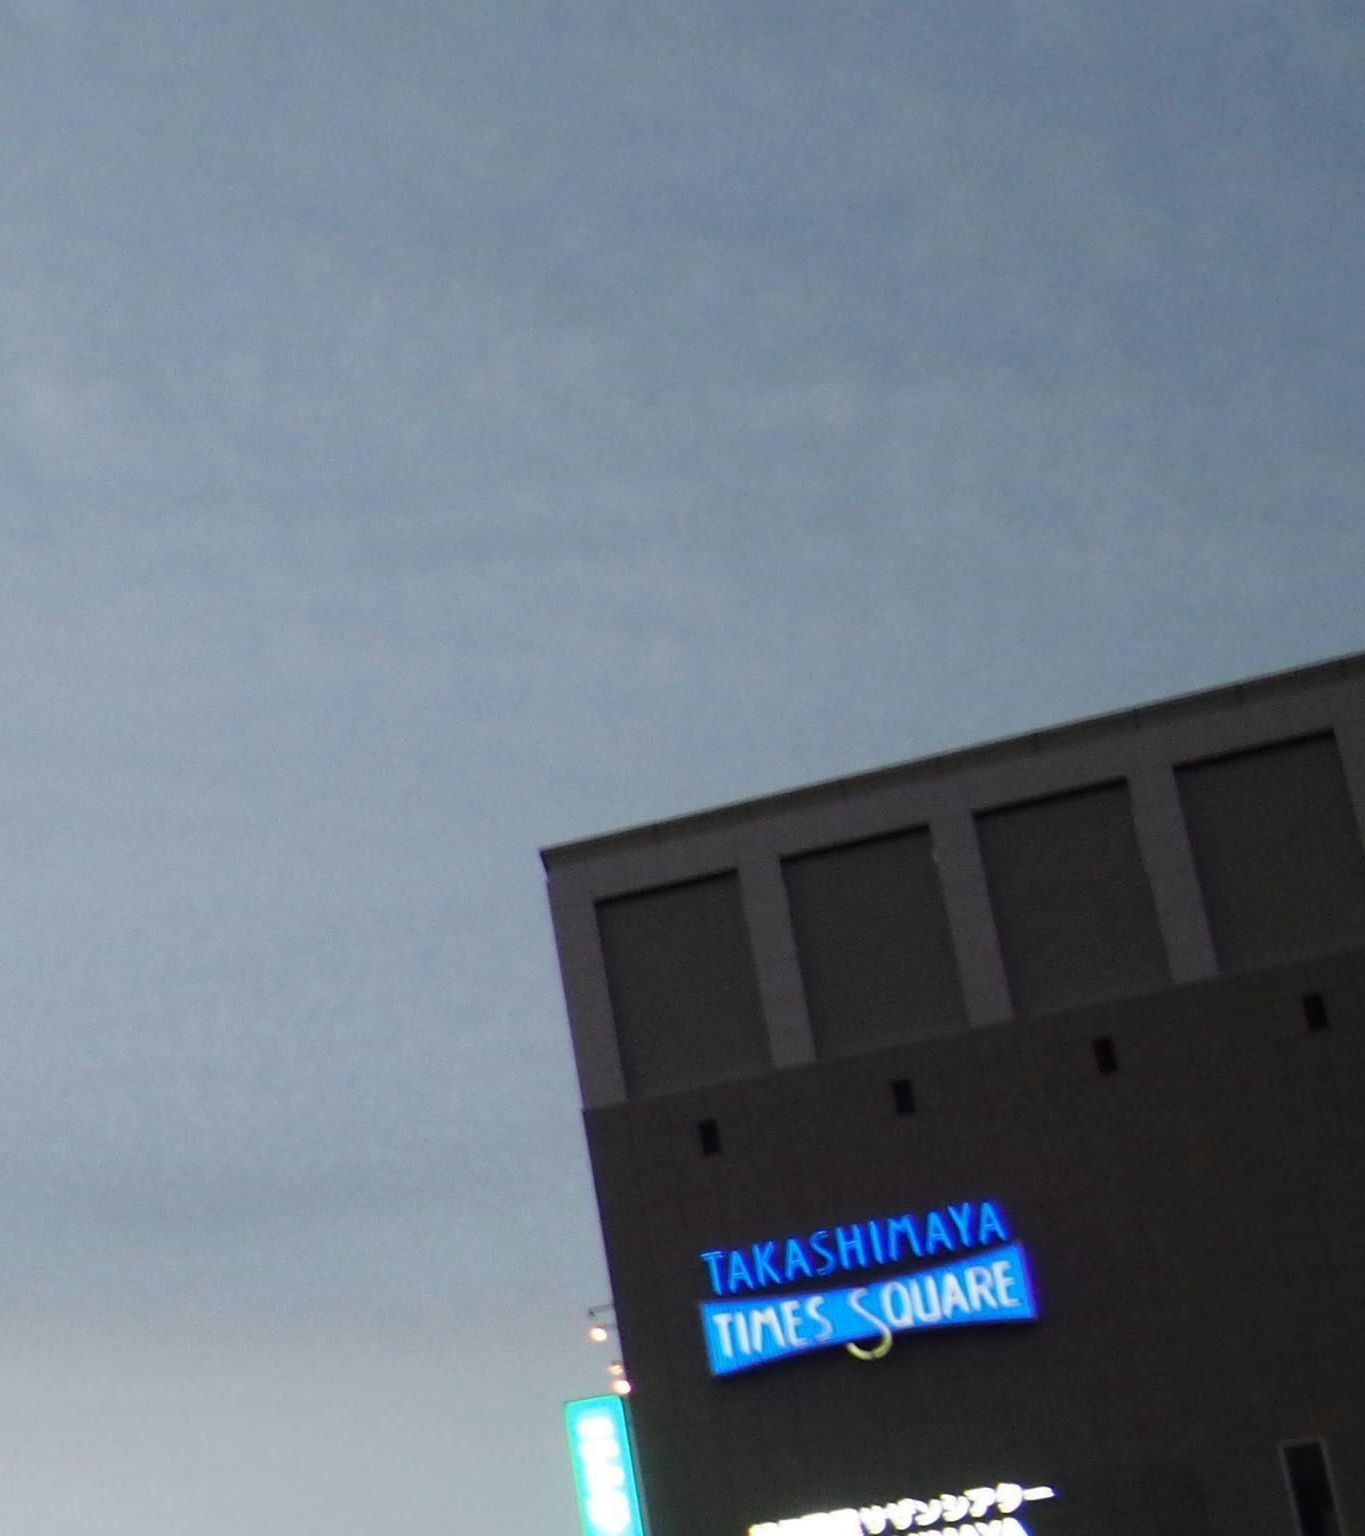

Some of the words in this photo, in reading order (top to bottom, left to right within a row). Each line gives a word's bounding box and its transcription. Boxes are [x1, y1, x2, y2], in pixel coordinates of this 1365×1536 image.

[701, 1200, 1007, 1296] TAKASHIMAYA
[712, 1296, 833, 1358] TIMES
[846, 1260, 1019, 1360] SQUARE
